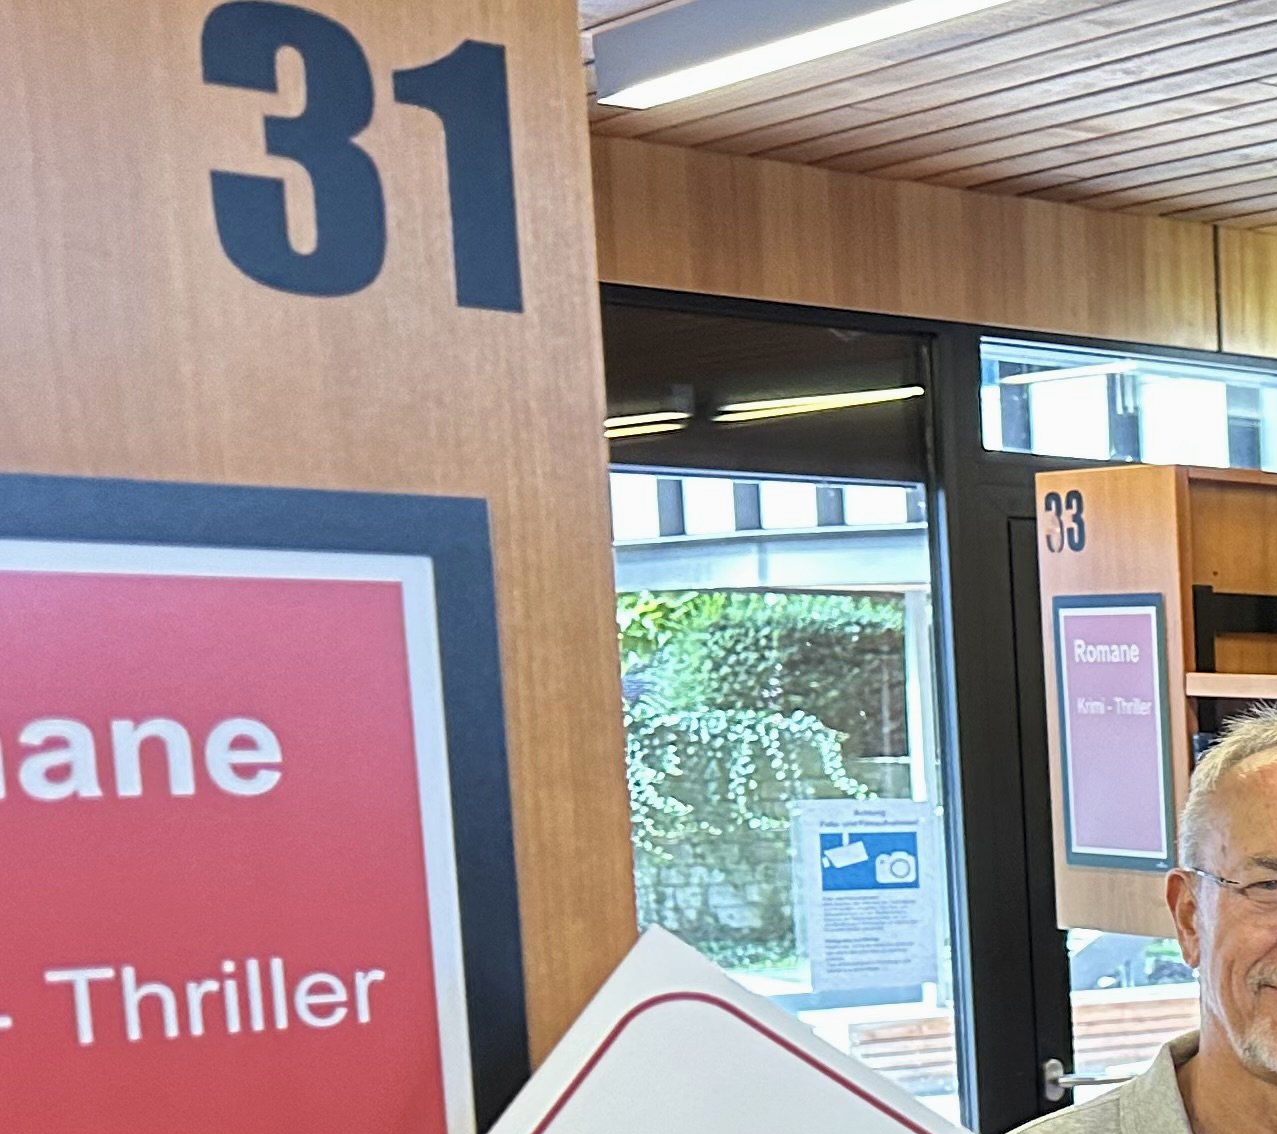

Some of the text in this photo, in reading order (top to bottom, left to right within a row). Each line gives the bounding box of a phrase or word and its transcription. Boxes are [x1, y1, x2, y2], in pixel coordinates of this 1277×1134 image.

[200, 1, 524, 313] 31
[1044, 489, 1086, 553] 33
[1074, 638, 1140, 664] Romane
[1076, 696, 1105, 716] Krimi
[1114, 696, 1152, 716] Thriller
[0, 714, 284, 800] ane
[44, 956, 386, 1046] Thriller
